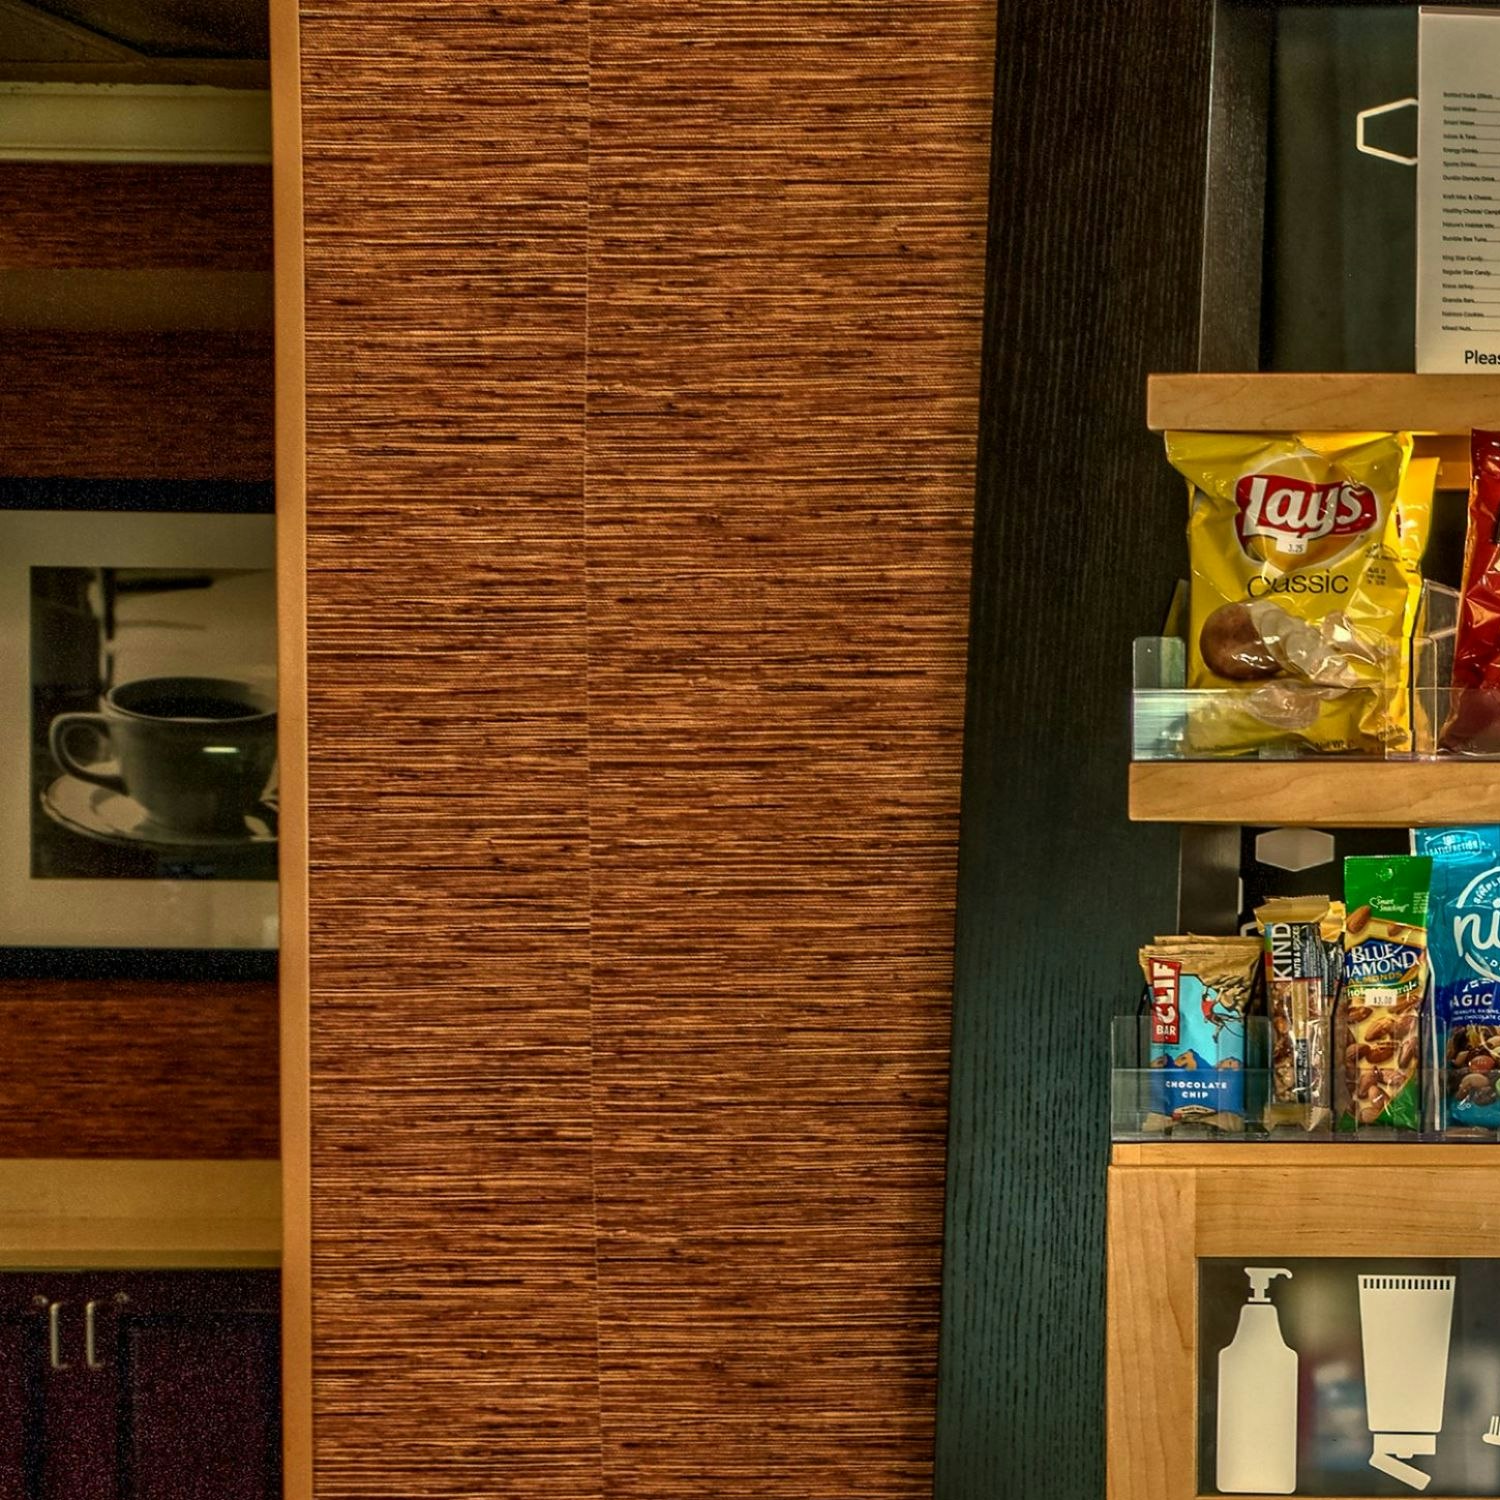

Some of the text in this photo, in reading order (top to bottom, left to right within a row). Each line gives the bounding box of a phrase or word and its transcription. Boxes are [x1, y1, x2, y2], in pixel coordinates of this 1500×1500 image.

[1272, 922, 1292, 981] KIND
[1351, 944, 1394, 964] BLUE
[1152, 961, 1177, 1026] CLIF
[1155, 1024, 1176, 1037] BAR
[1165, 1080, 1228, 1090] CHOCOLATE
[1181, 1091, 1209, 1099] CHIP
